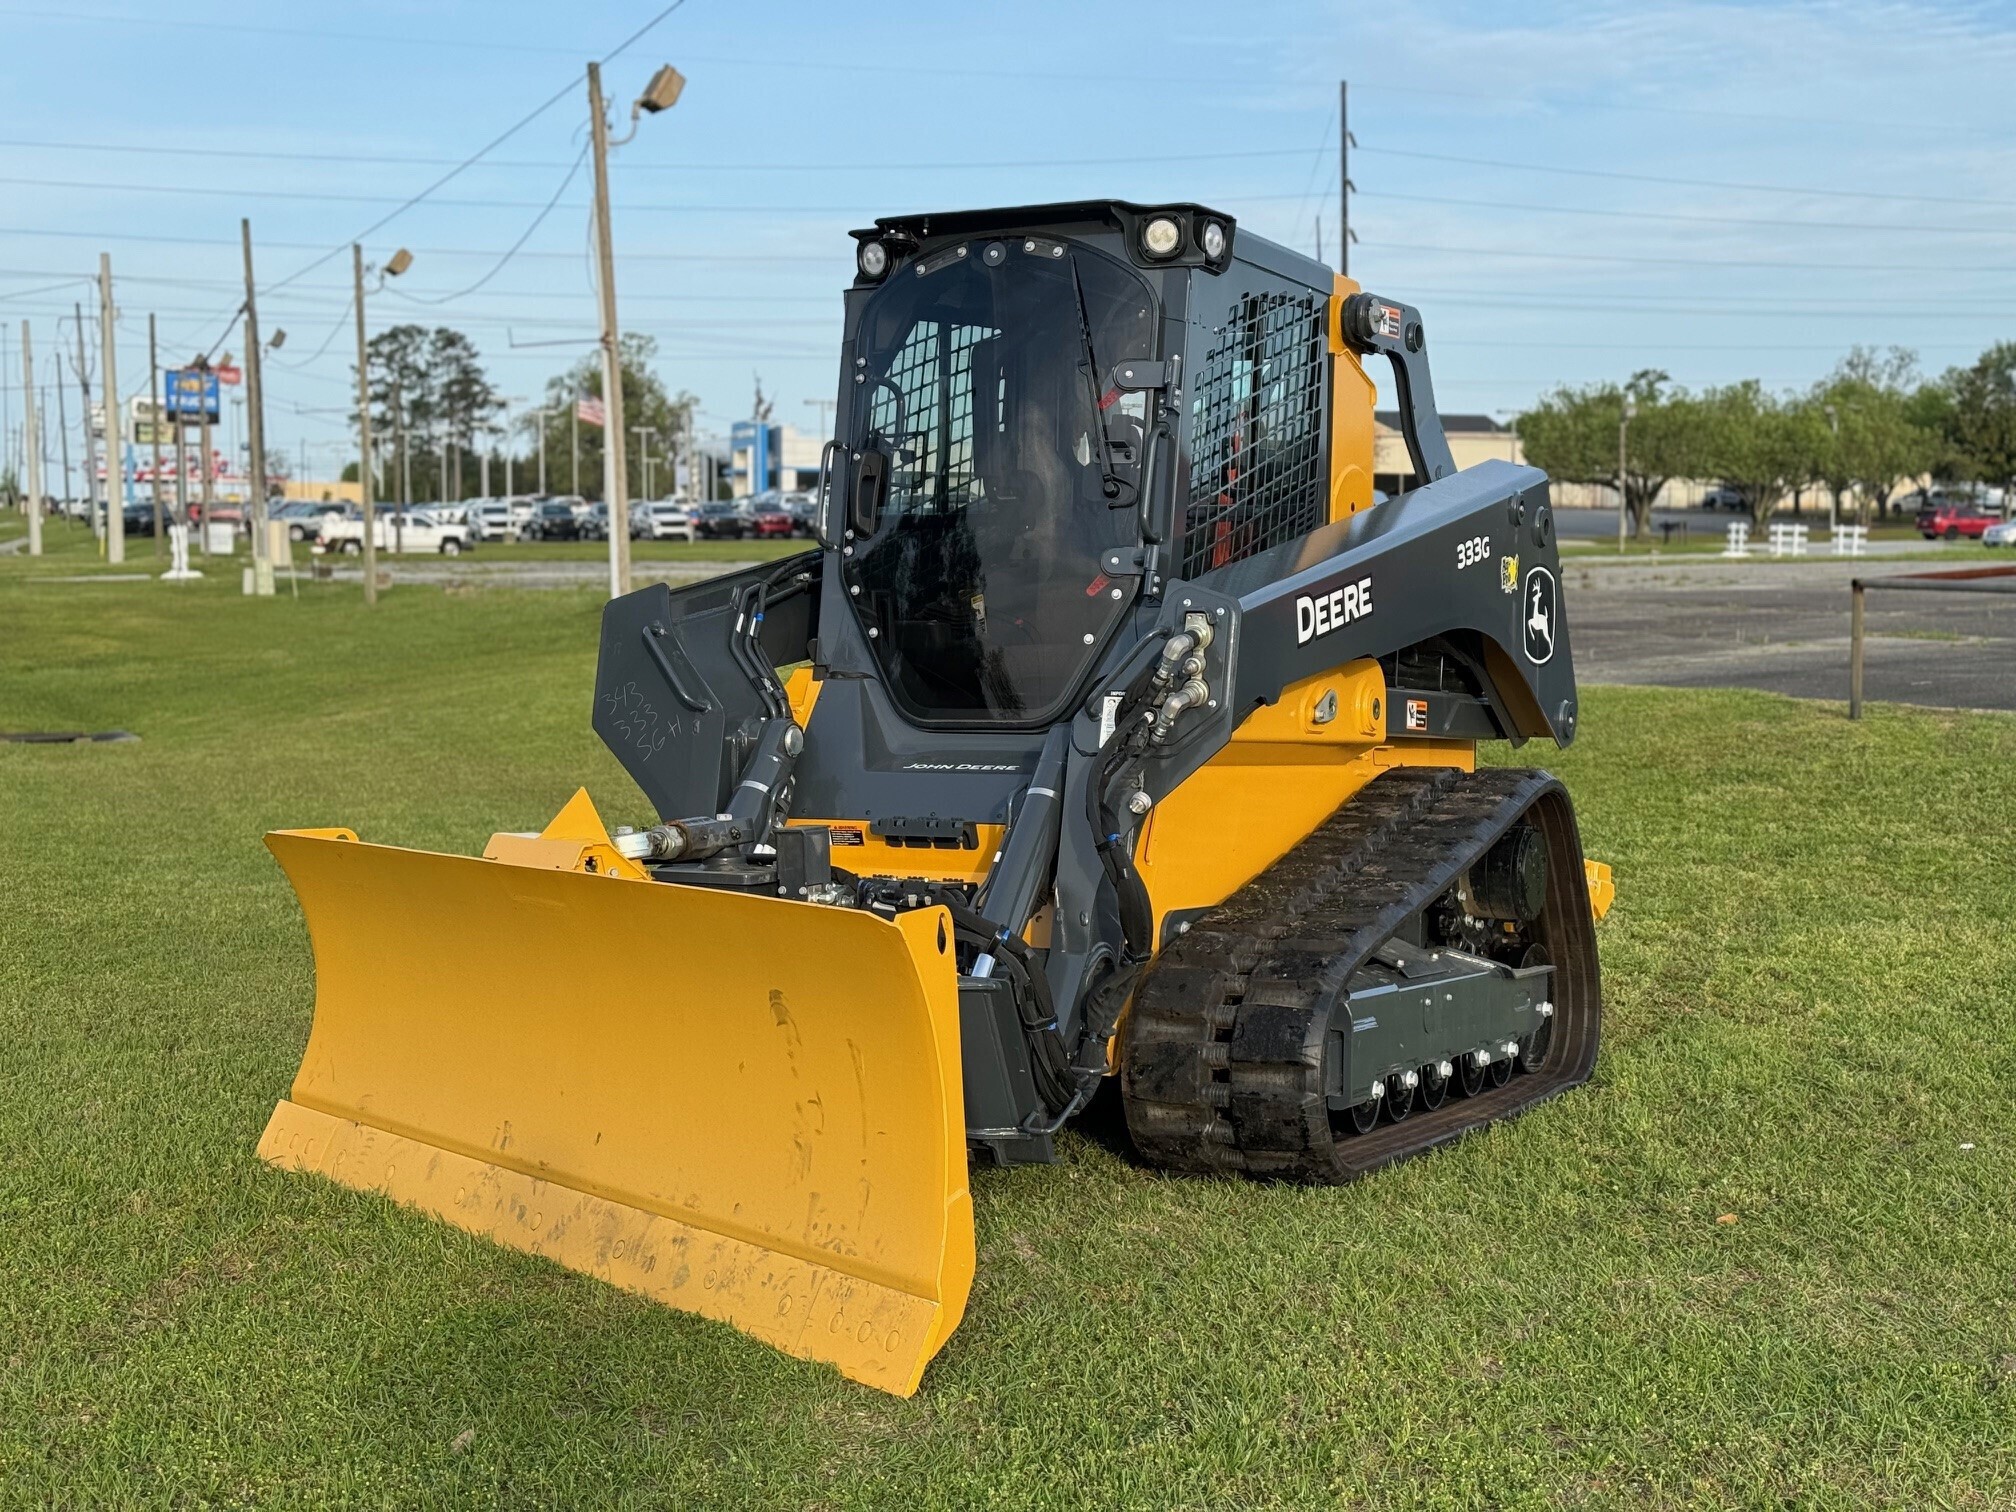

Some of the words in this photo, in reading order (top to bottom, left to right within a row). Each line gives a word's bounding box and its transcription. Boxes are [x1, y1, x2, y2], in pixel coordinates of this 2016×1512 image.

[1457, 536, 1490, 570] 333G
[1296, 577, 1373, 644] DEERE
[955, 763, 1020, 771] DEERE
